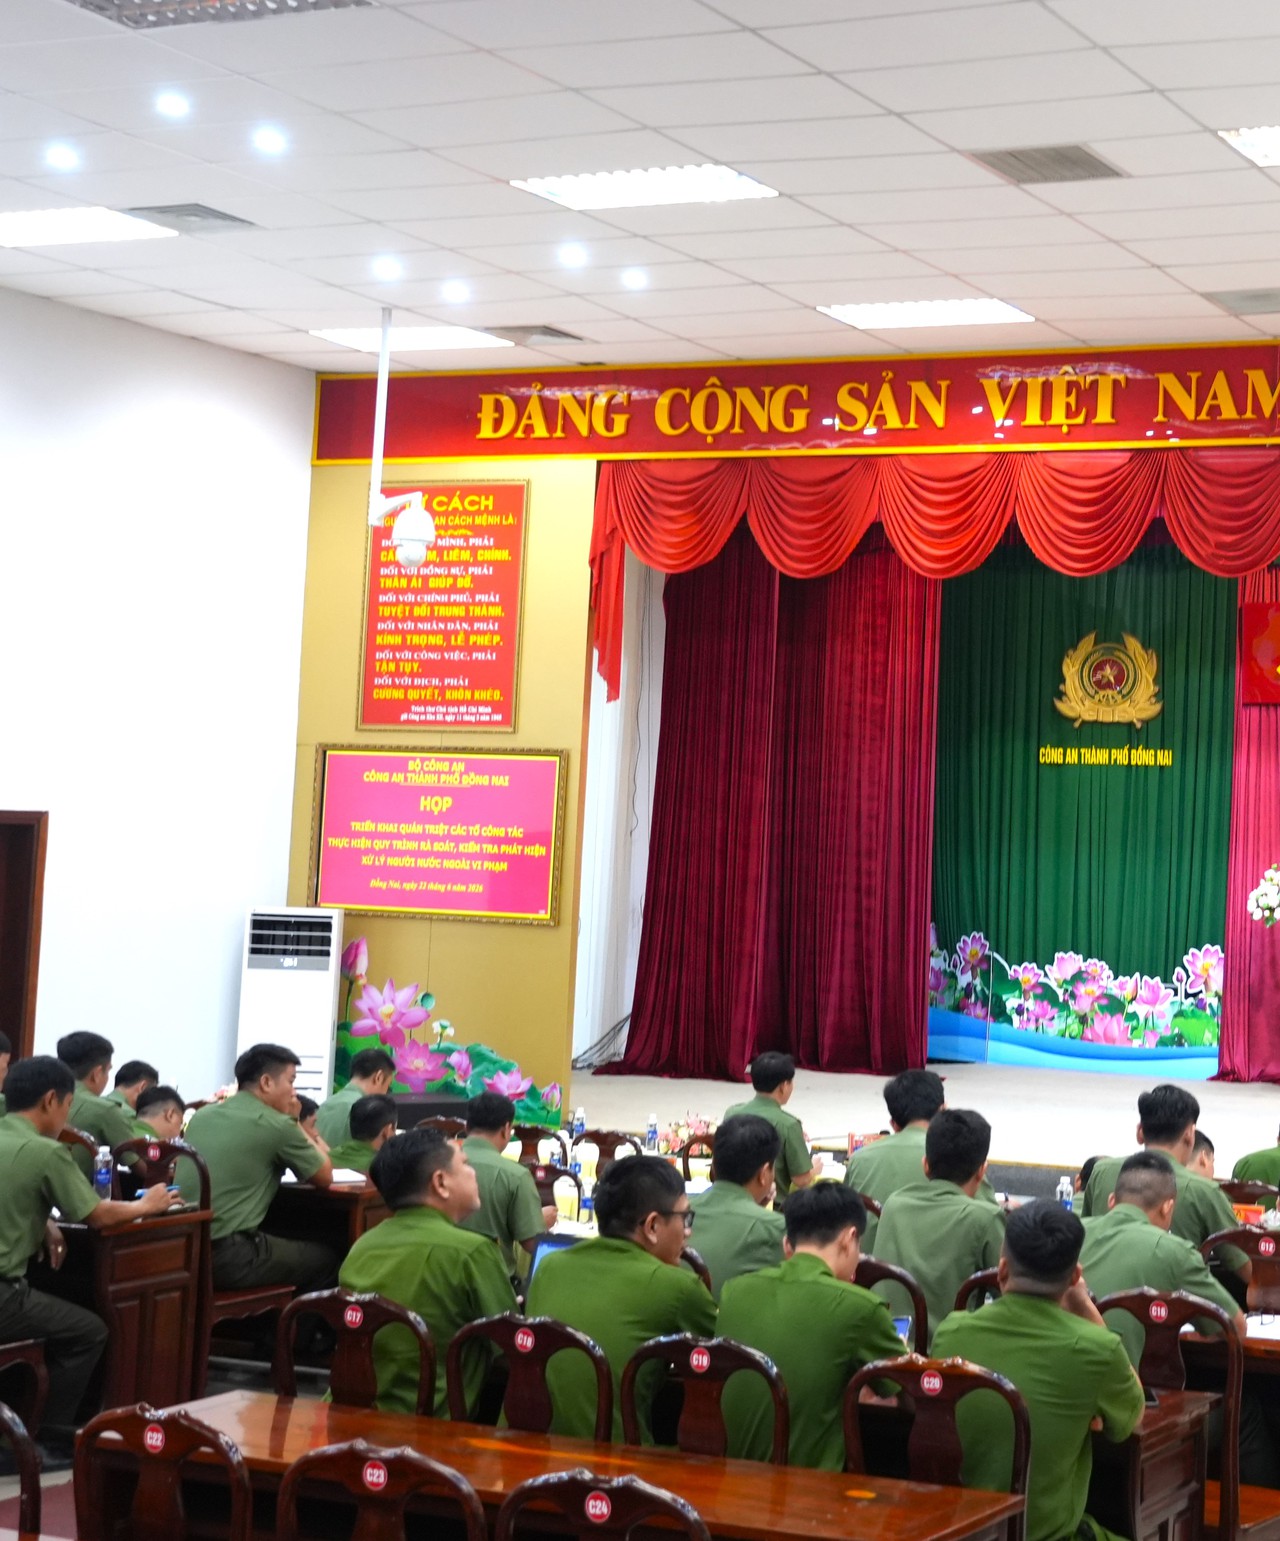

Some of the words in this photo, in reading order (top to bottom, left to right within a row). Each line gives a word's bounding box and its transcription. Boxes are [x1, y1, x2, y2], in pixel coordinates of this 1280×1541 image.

[477, 380, 630, 441] ĐẢNG
[655, 377, 810, 444] CỘNG
[836, 370, 949, 433] SẢN
[979, 363, 1125, 435] VIỆT
[433, 491, 493, 511] CÁCH
[444, 548, 473, 562] LIÊM,
[478, 548, 512, 561] CHÍNH.
[1039, 744, 1063, 764] CÔNG
[1066, 747, 1078, 764] AN
[1080, 745, 1108, 765] THÀNH
[1111, 744, 1129, 765] PHỐ
[1157, 749, 1172, 766] NAI
[408, 758, 420, 772] BỘ
[423, 759, 449, 772] CÔNG
[451, 762, 464, 772] AN
[364, 769, 389, 782] CÔNG
[391, 773, 404, 782] AN
[406, 772, 438, 783] THÀNH
[441, 771, 460, 784] PHỐ
[462, 772, 489, 786] ĐỒNG
[492, 776, 509, 786] NAI
[420, 796, 452, 815] HỌP
[347, 1311, 361, 1322] C17
[1151, 1305, 1166, 1317] C16
[517, 1334, 532, 1346] C18
[692, 1354, 708, 1366] C19
[923, 1377, 940, 1388] C20
[146, 1432, 163, 1445] C22
[366, 1469, 385, 1482] C23
[588, 1500, 608, 1515] C24
